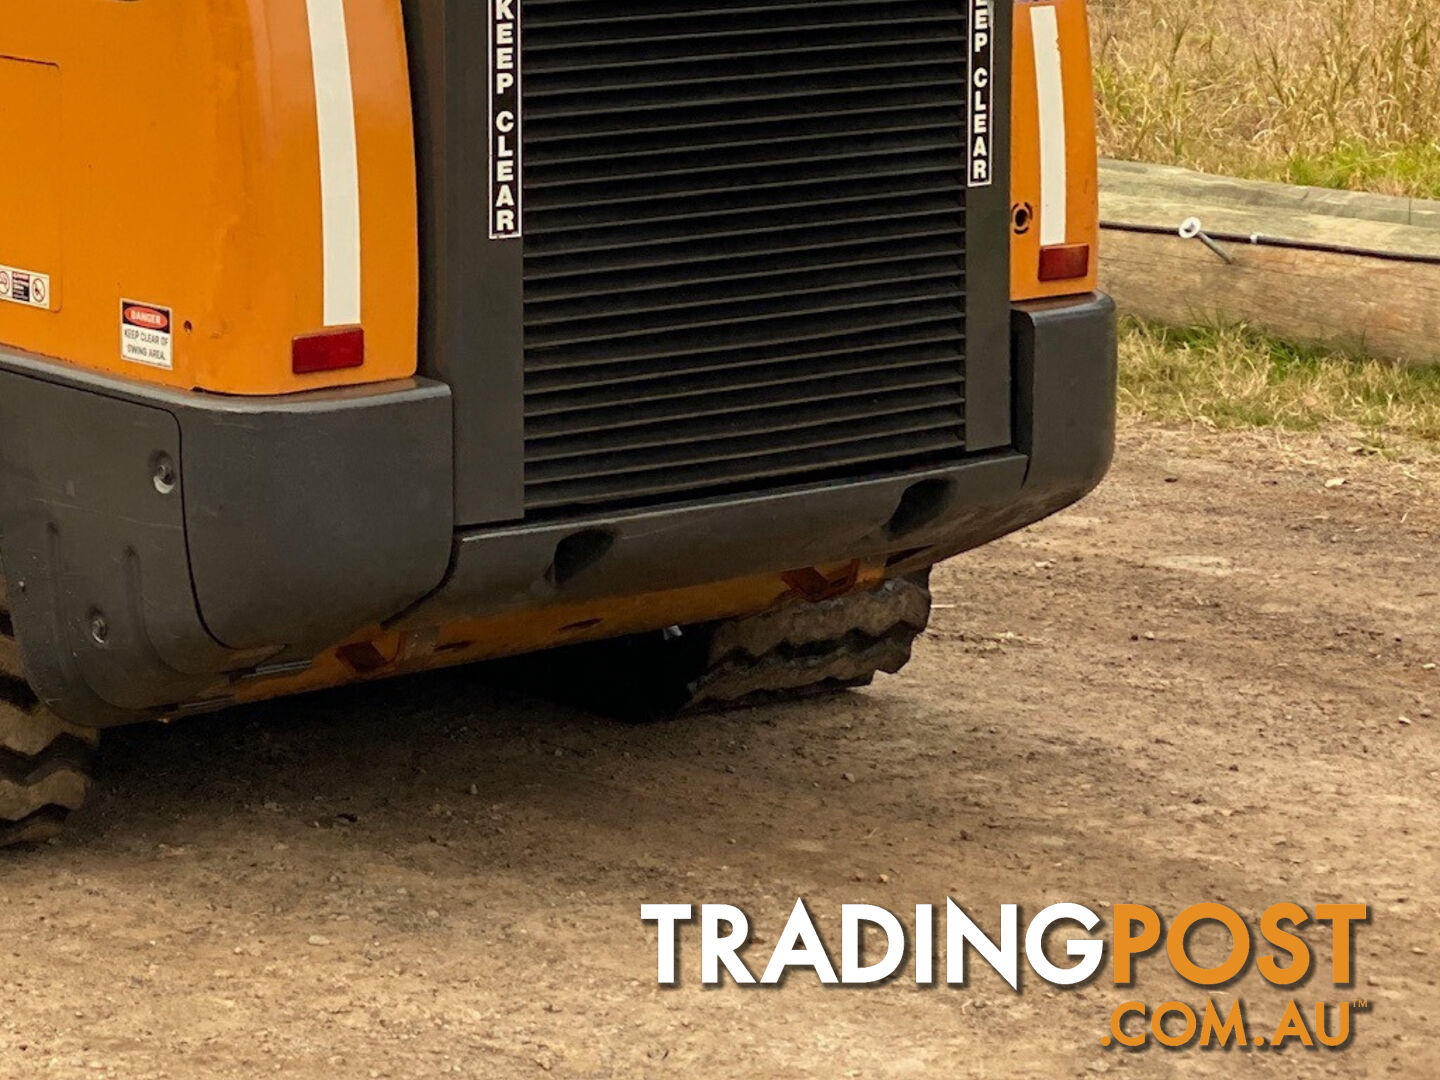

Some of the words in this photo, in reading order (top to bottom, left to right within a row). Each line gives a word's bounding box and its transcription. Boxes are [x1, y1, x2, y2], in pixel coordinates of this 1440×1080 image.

[495, 110, 515, 232] CLEAR
[972, 67, 988, 180] CLEAR
[140, 331, 159, 345] CLEAR
